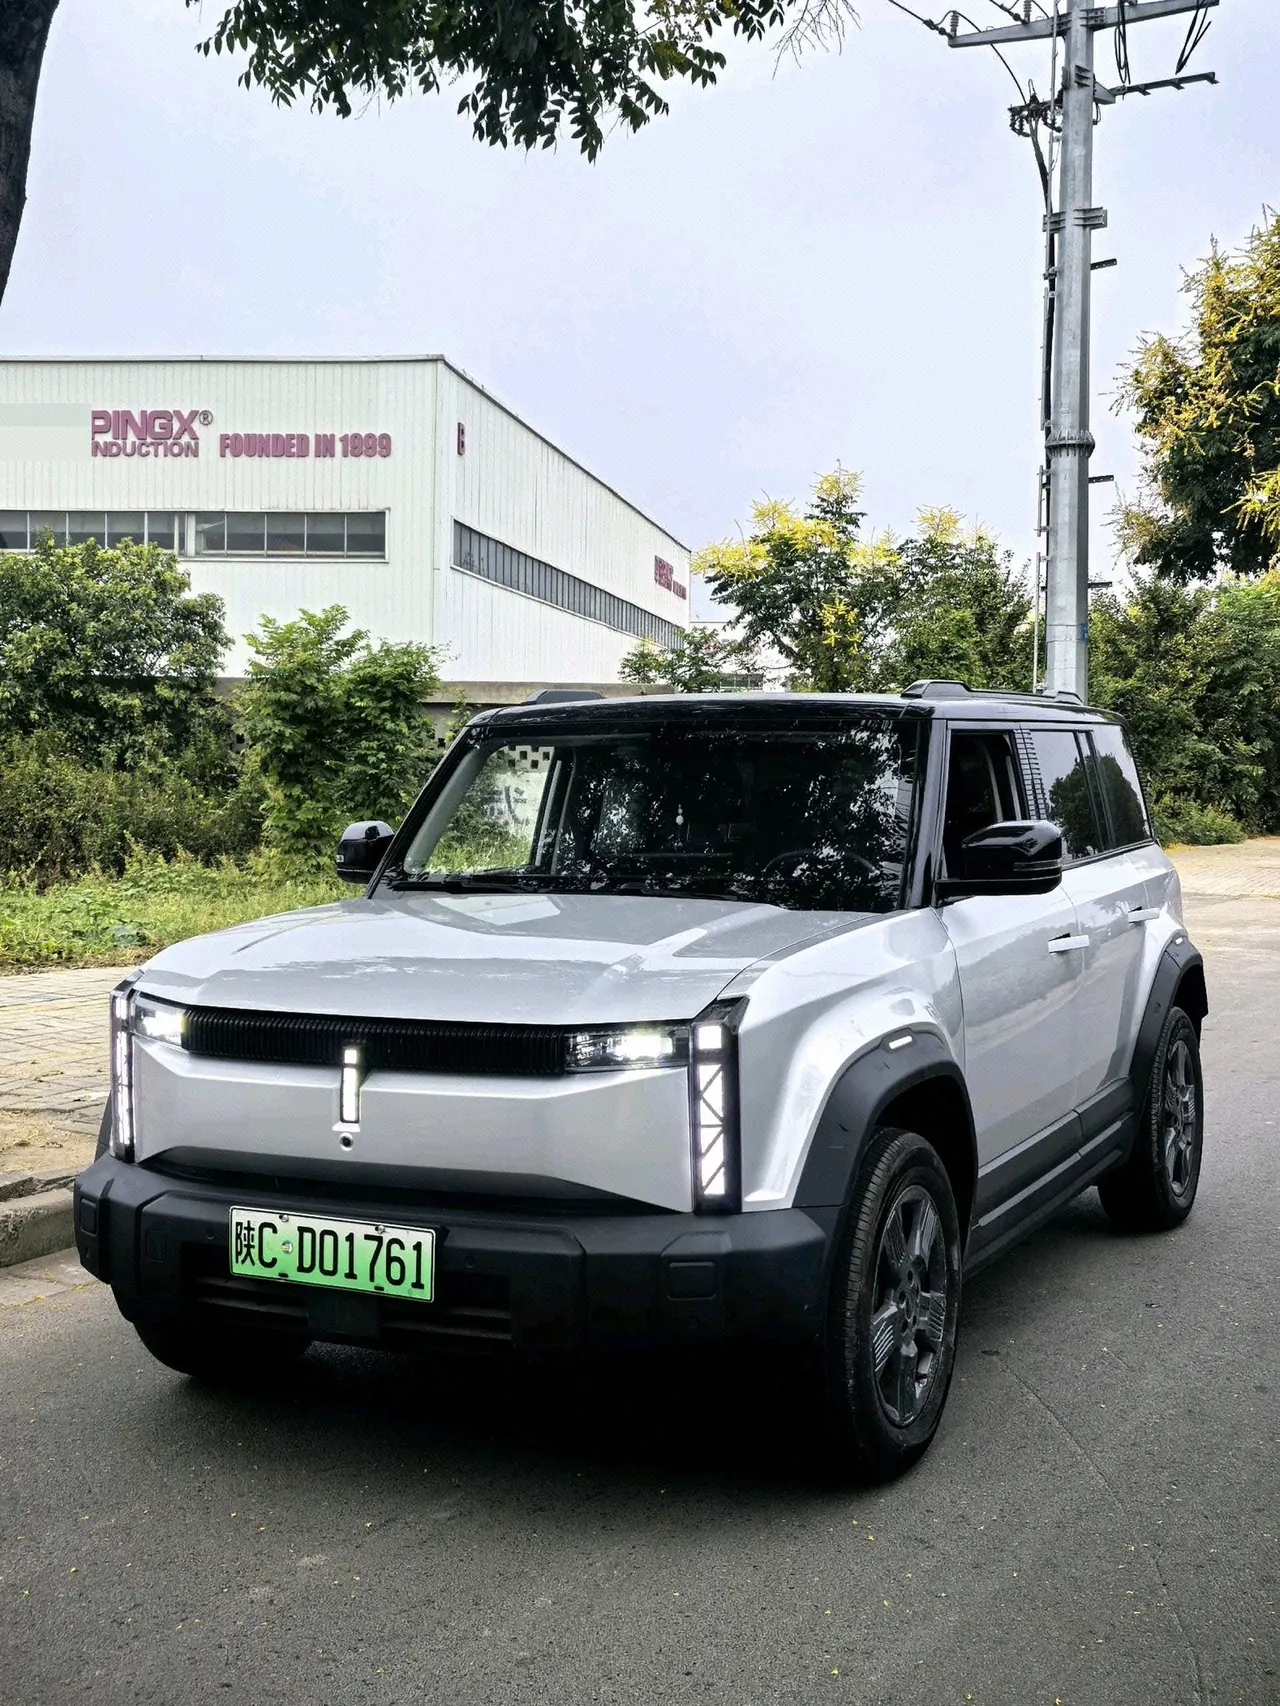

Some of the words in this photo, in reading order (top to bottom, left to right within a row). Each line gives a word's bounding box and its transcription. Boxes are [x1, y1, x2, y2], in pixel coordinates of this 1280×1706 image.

[219, 433, 310, 458] FOUNDED
[314, 433, 336, 458] IN
[339, 433, 392, 458] 1999
